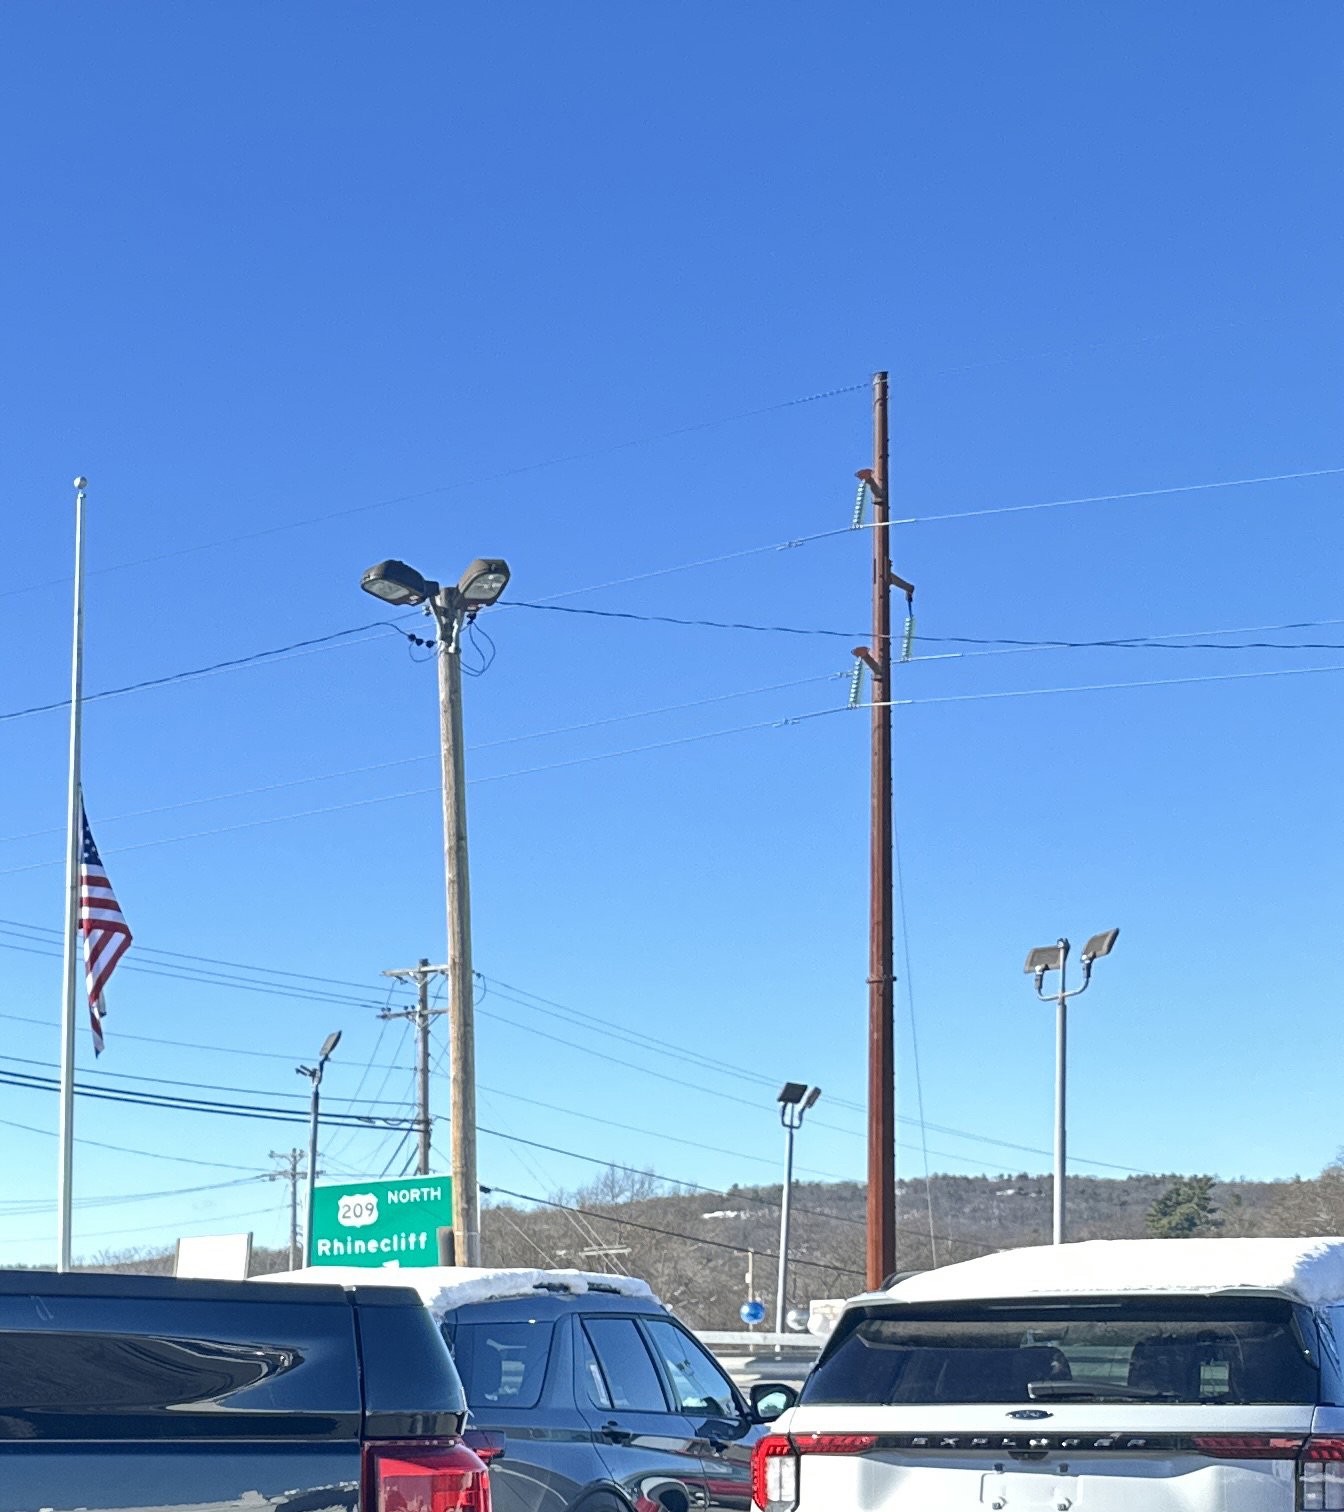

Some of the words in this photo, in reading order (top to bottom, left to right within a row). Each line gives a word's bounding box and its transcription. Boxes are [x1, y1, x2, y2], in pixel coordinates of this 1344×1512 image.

[342, 1202, 375, 1219] 209
[387, 1187, 442, 1204] NORTH
[317, 1232, 428, 1256] Rhinecliff
